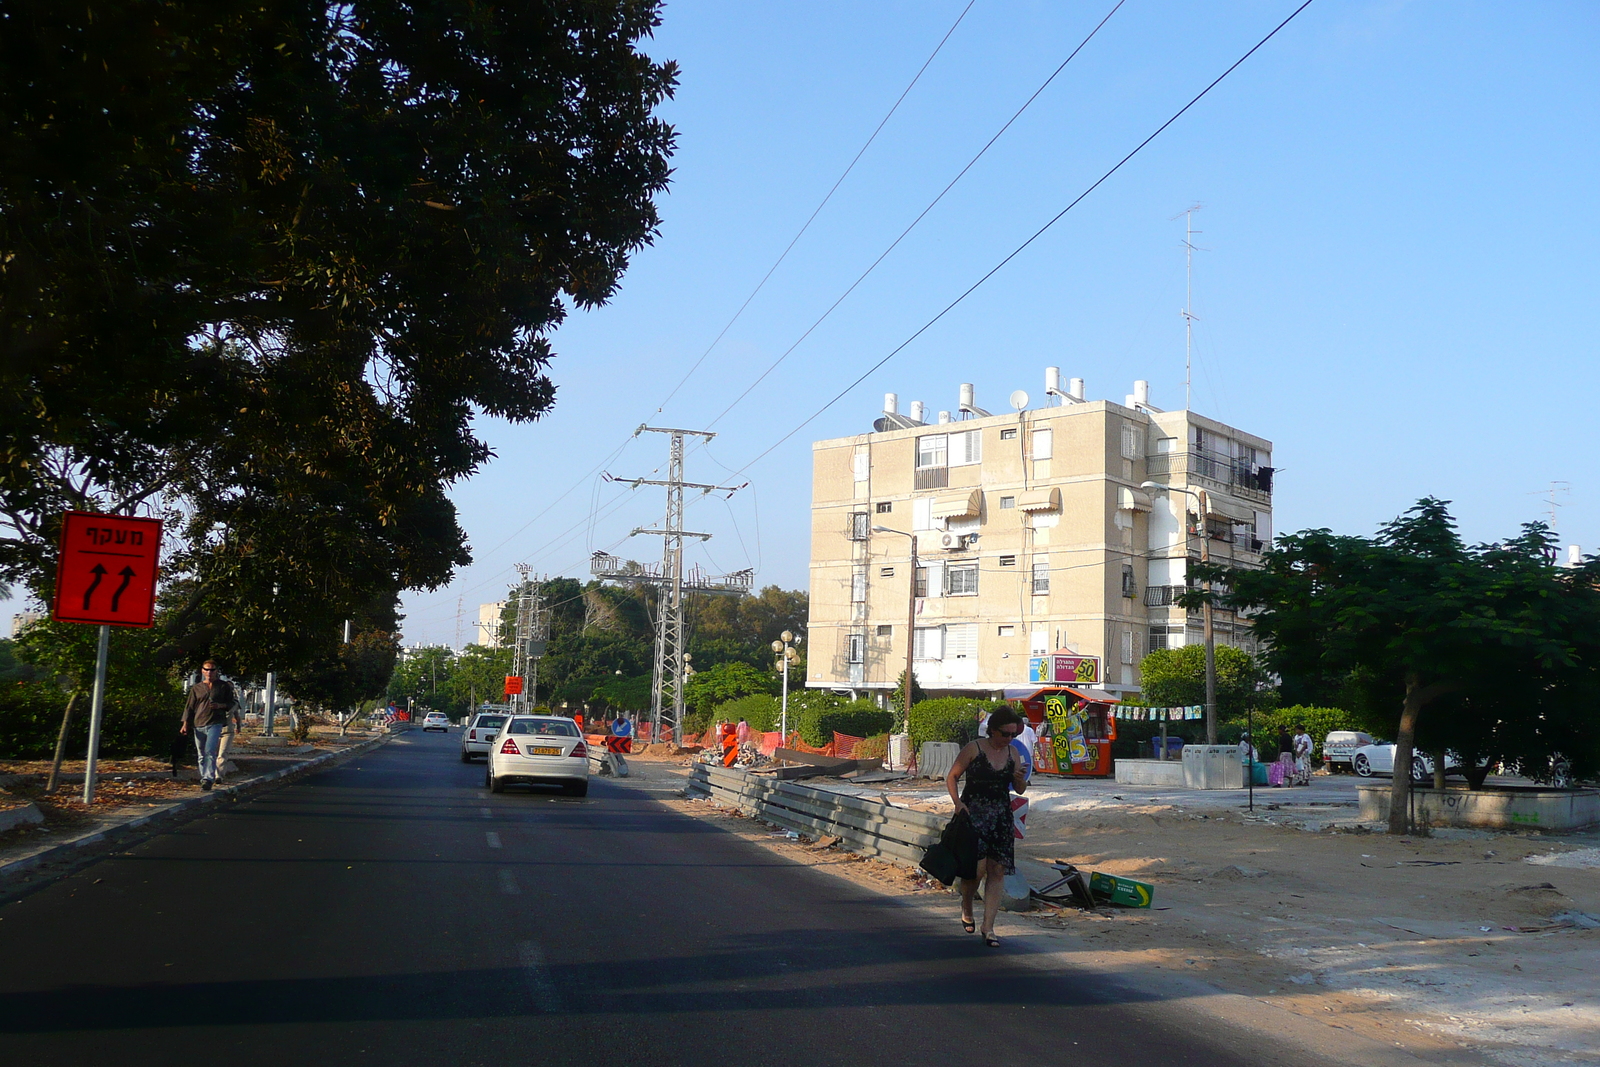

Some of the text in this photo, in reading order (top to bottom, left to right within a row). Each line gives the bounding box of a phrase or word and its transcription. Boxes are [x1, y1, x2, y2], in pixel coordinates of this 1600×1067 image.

[86, 527, 144, 546] מעקף
[1078, 661, 1094, 677] 50
[1048, 704, 1063, 716] 50
[1056, 738, 1067, 748] 50
[1070, 739, 1086, 759] 5
